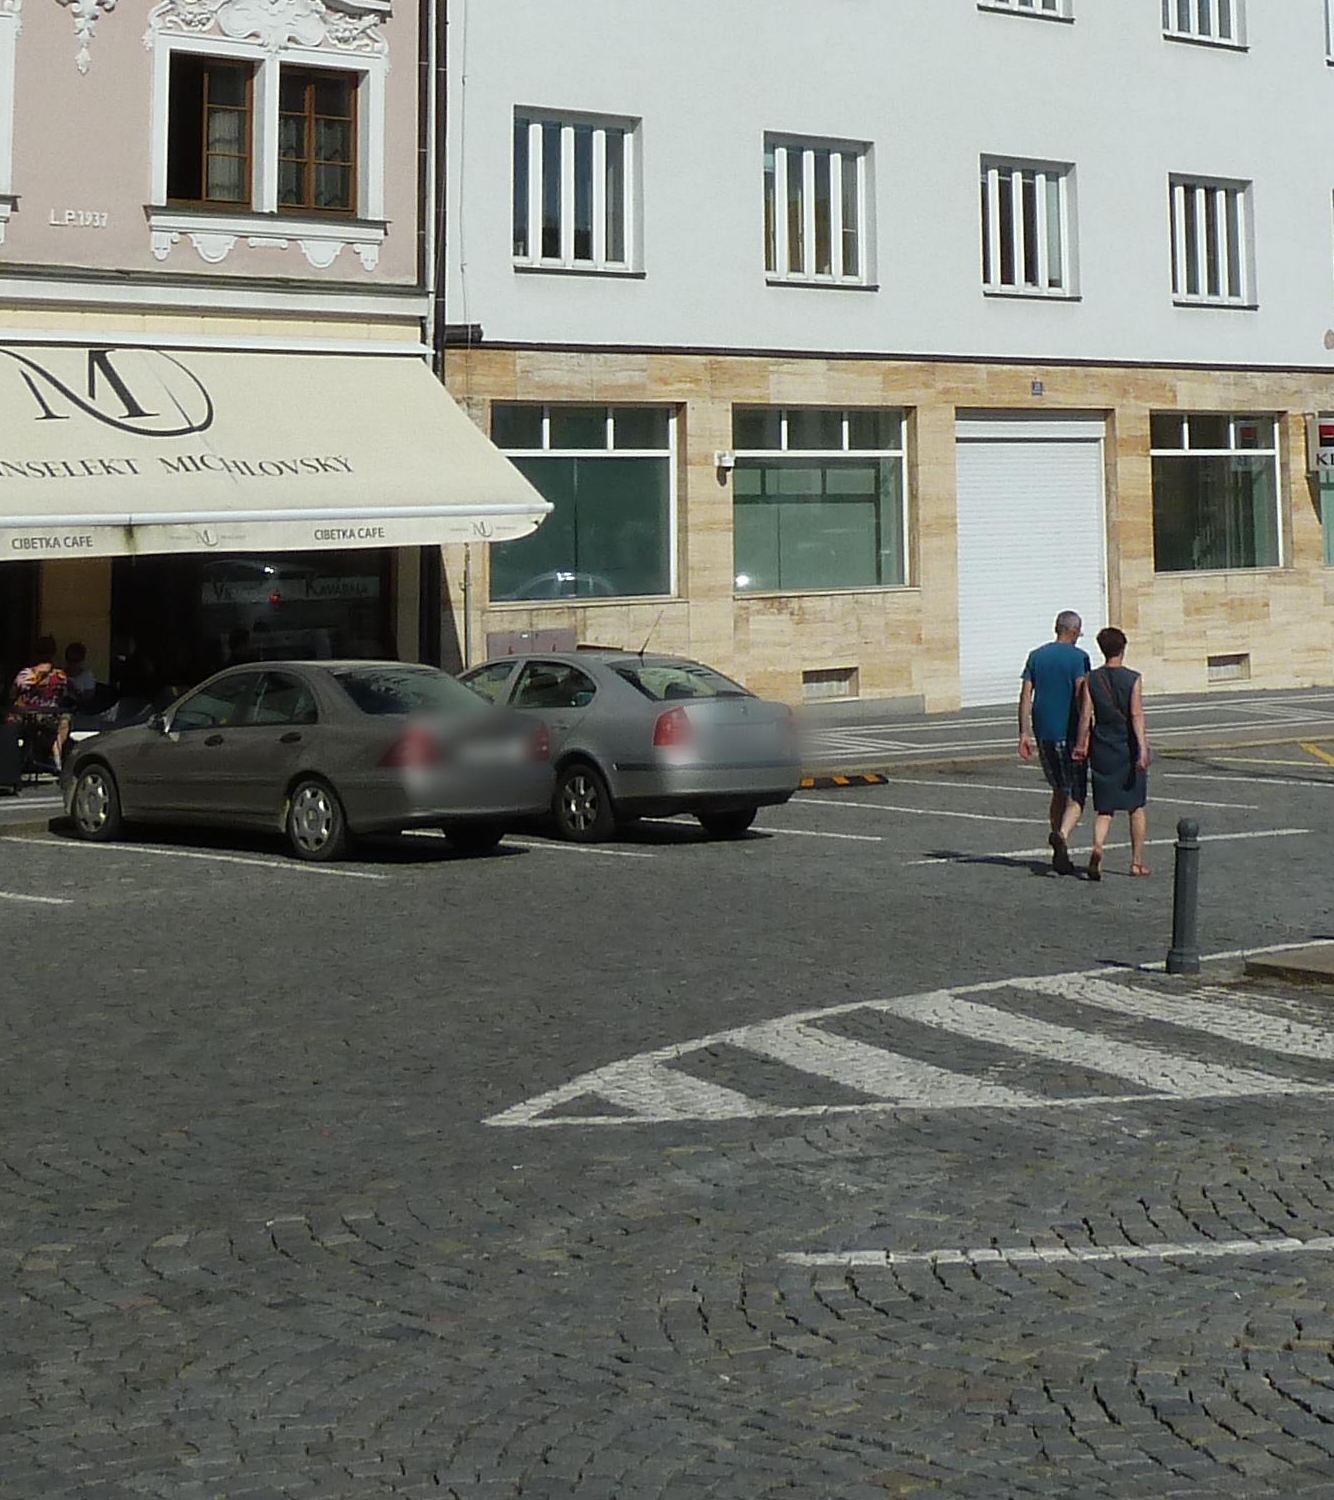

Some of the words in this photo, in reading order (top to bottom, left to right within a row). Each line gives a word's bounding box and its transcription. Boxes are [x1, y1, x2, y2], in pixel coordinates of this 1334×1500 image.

[314, 528, 356, 541] CIBETKA
[357, 526, 386, 539] CAFE
[11, 536, 61, 550] CIBETKA
[63, 535, 94, 548] CAFE
